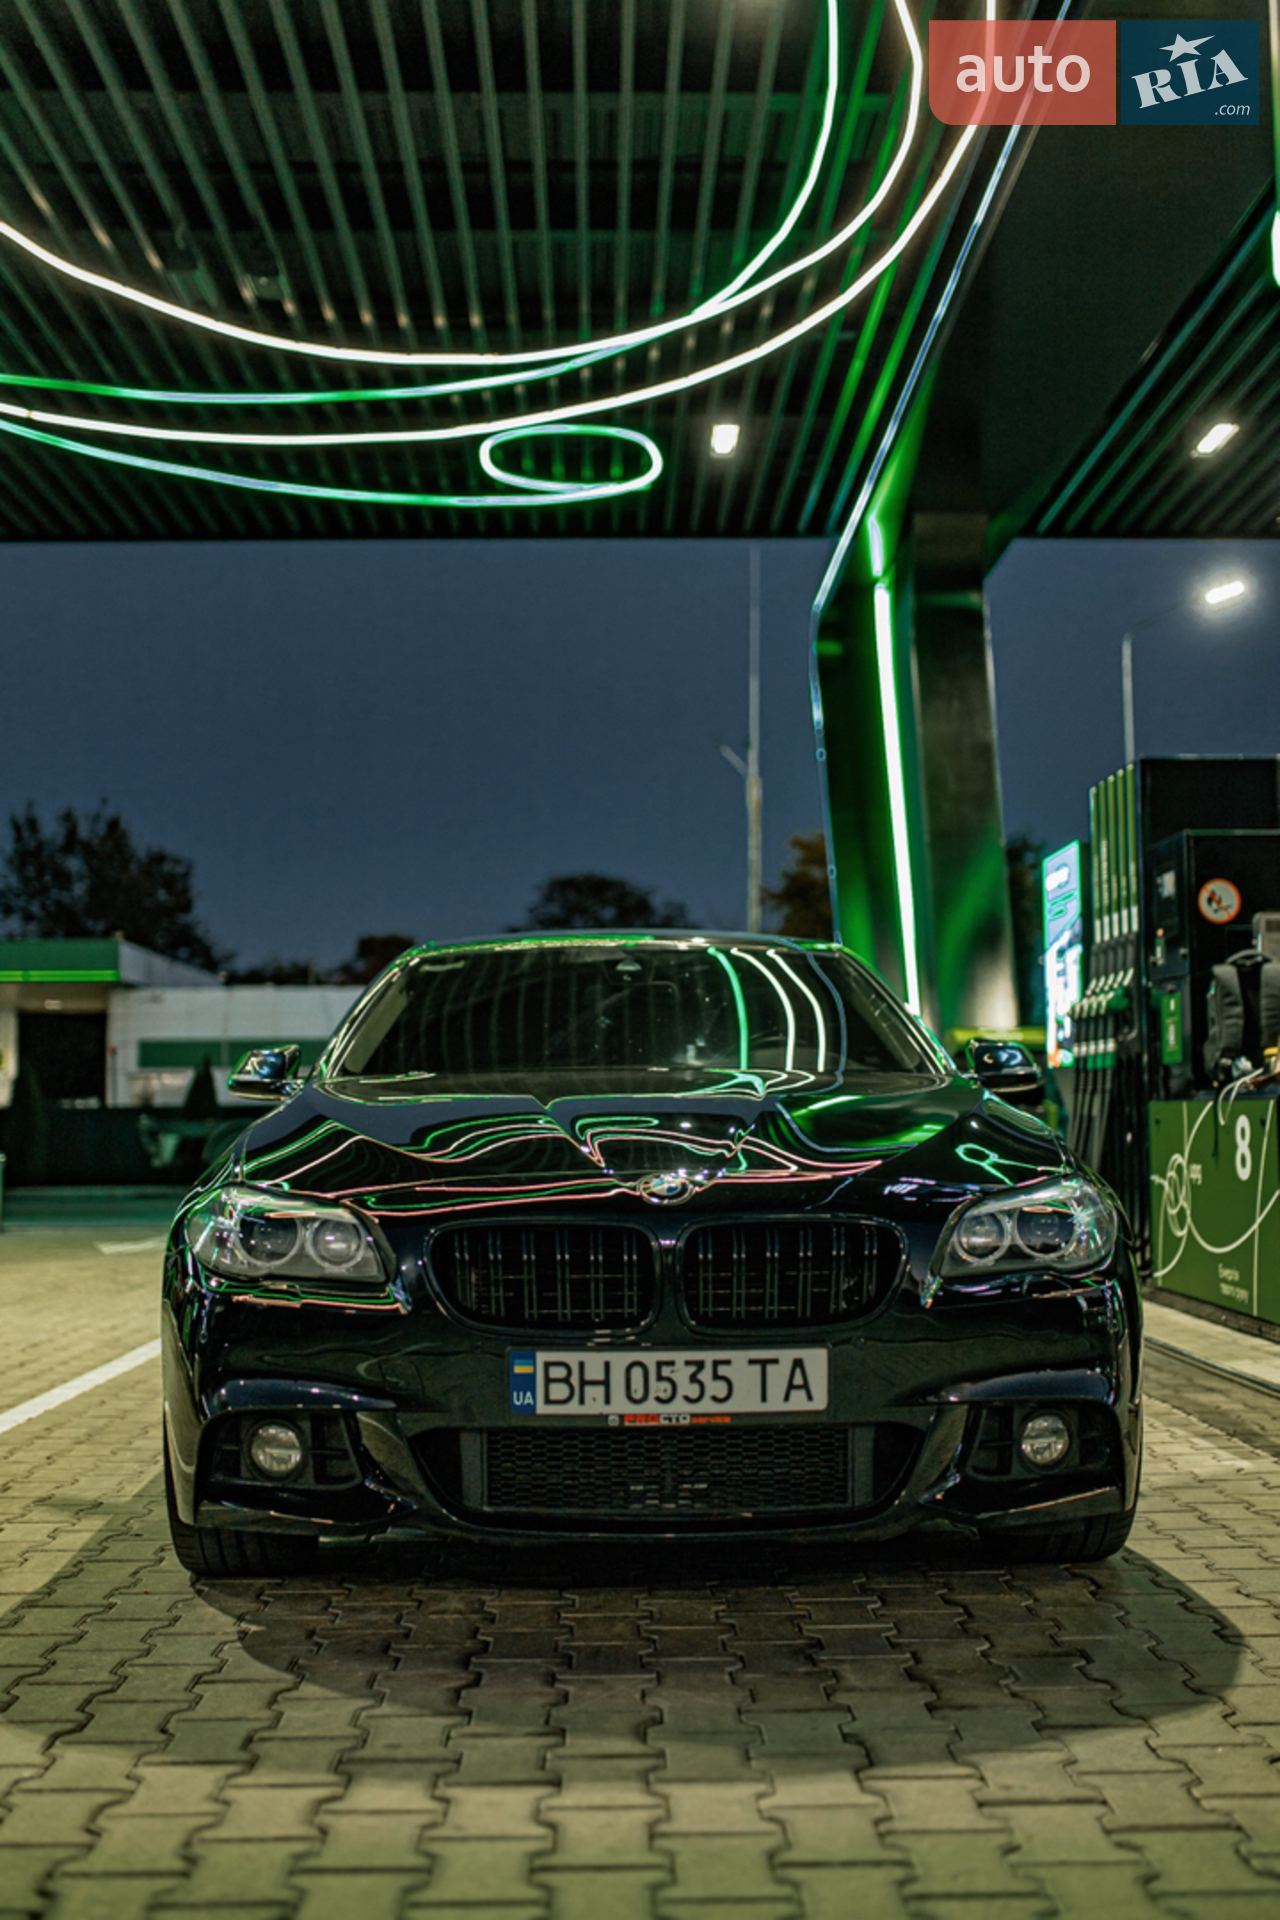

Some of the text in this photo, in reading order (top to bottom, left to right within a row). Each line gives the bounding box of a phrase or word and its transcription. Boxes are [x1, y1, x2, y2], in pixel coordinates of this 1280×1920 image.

[1235, 1114, 1252, 1181] 8
[512, 1391, 534, 1406] UA
[543, 1358, 814, 1406] BH 0535 TA
